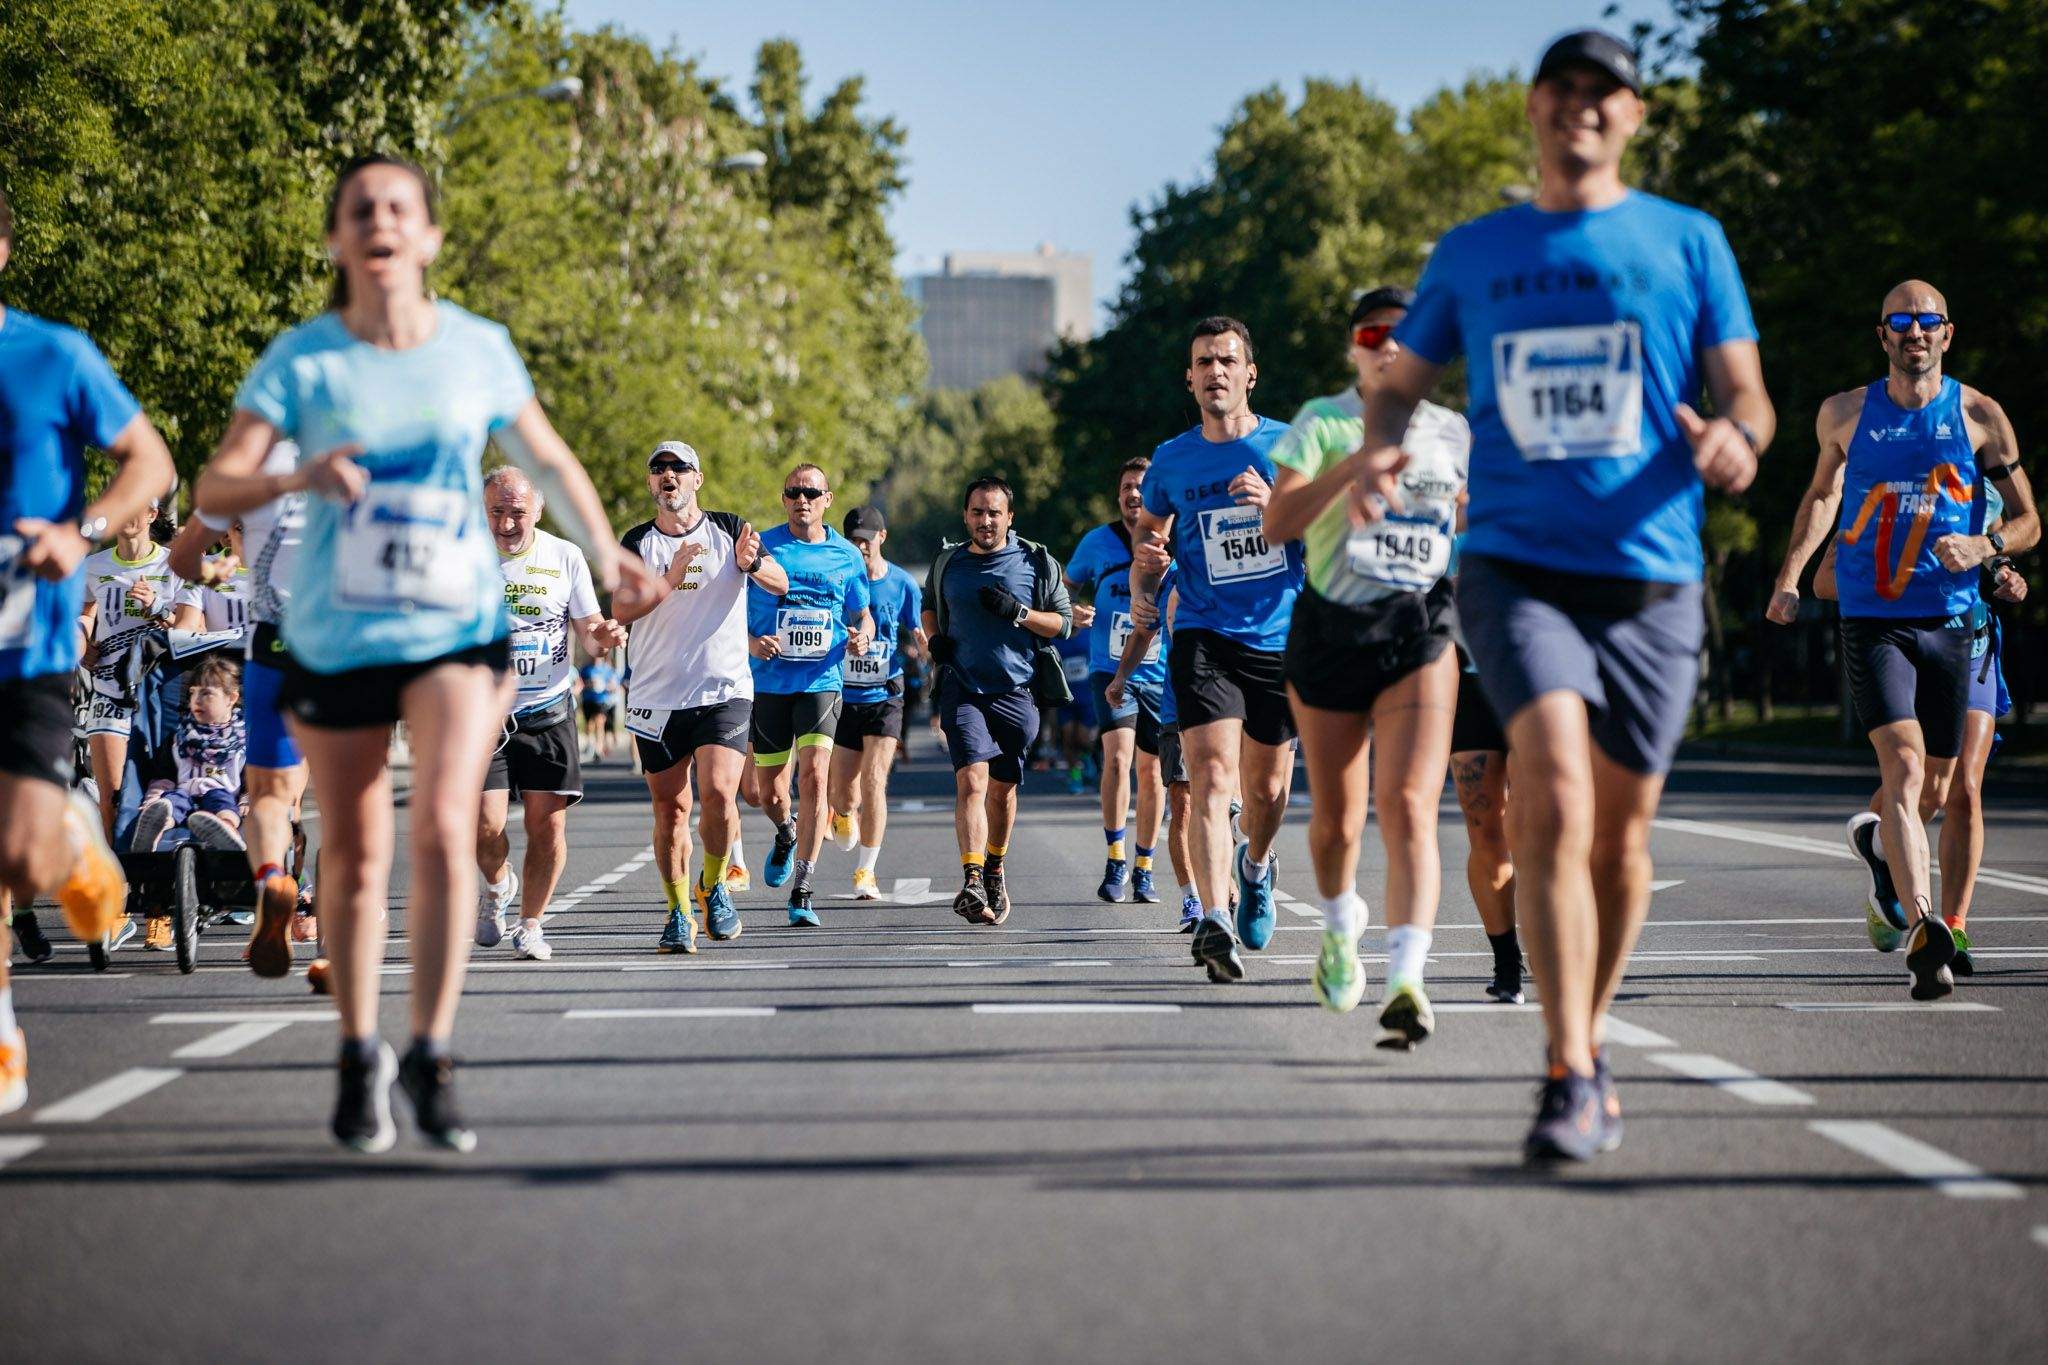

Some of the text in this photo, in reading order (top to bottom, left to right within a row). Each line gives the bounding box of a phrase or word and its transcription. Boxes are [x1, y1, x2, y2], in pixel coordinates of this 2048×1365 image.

[1532, 383, 1606, 418] 1164
[1899, 493, 1939, 514] FAST
[1225, 527, 1262, 538] DECIMA
[1220, 535, 1270, 561] 1540
[1374, 535, 1431, 563] 1949
[504, 595, 518, 604] DE
[505, 606, 540, 616] UEGO
[788, 631, 822, 646] 1099
[849, 660, 880, 674] 1054
[93, 702, 124, 719] 1926
